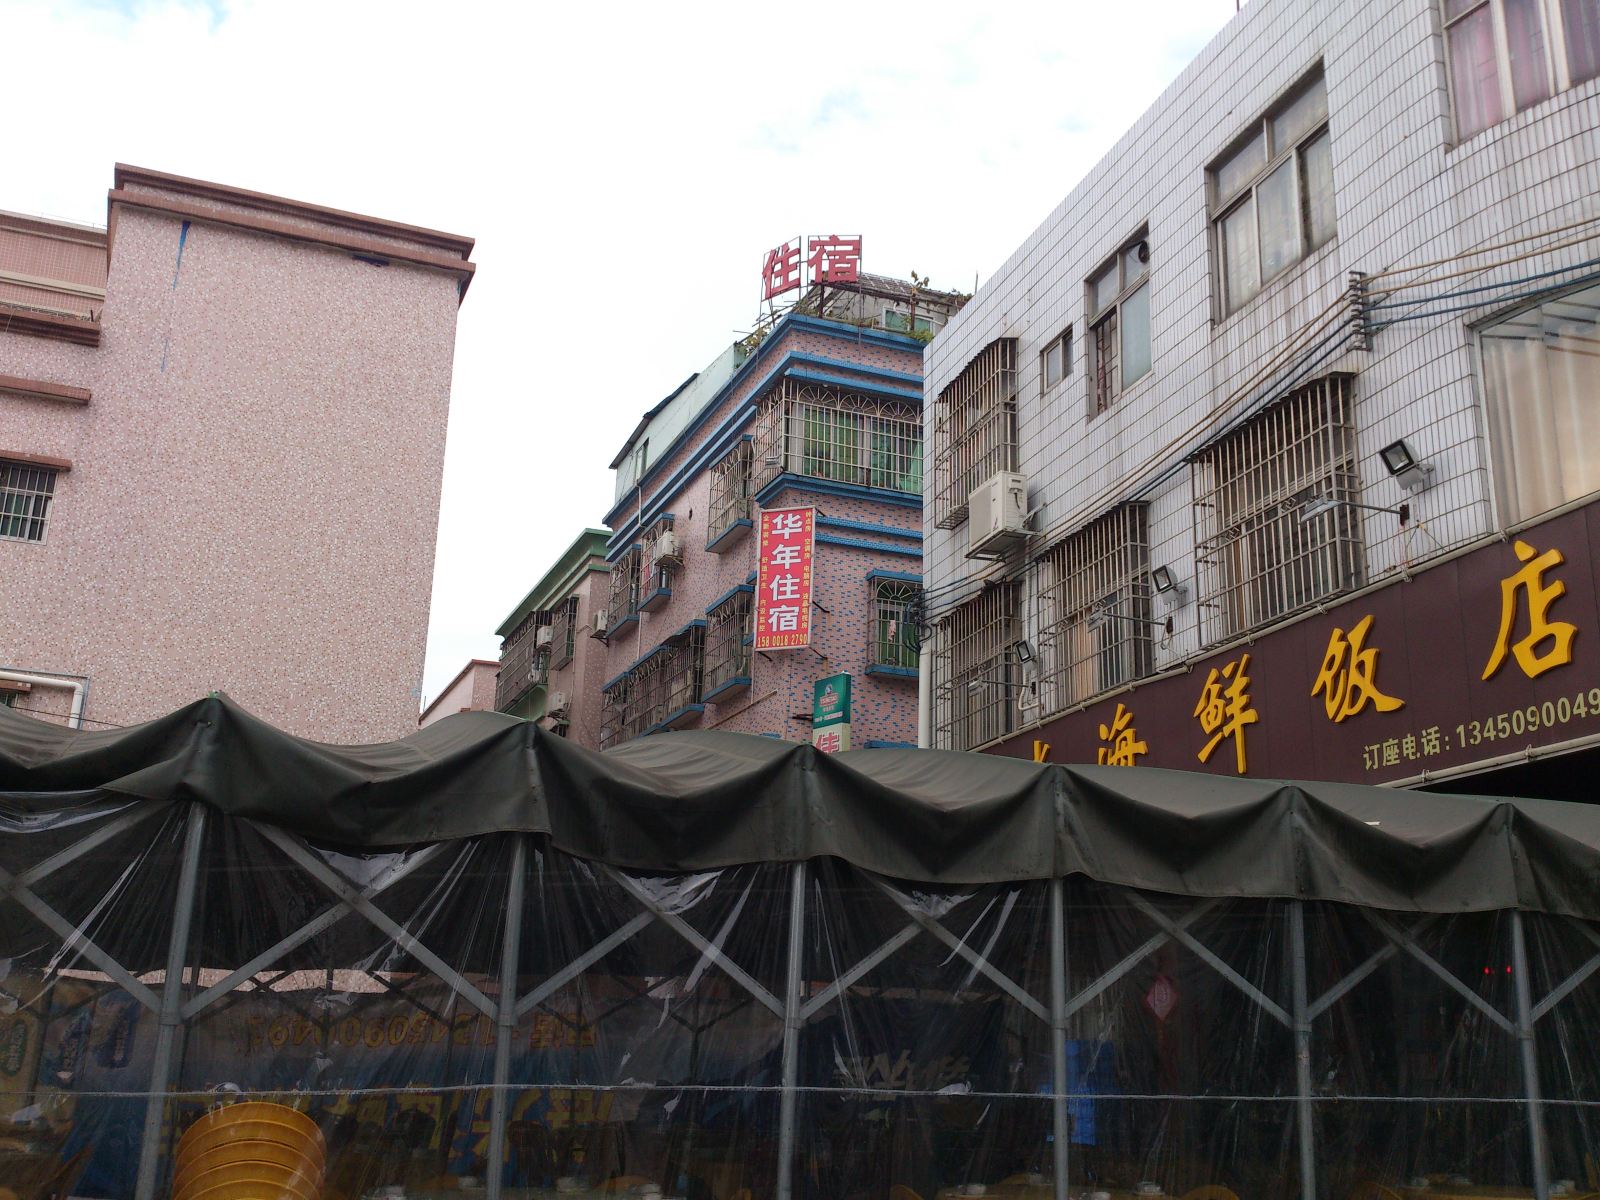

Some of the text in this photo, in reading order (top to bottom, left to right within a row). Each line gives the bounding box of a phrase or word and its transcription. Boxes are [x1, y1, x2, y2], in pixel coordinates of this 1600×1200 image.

[762, 234, 861, 299] 住宿
[768, 513, 802, 632] 华年住宿
[757, 635, 770, 647] 158
[772, 634, 788, 646] 0018
[1033, 541, 1578, 774] 海鲜饭店
